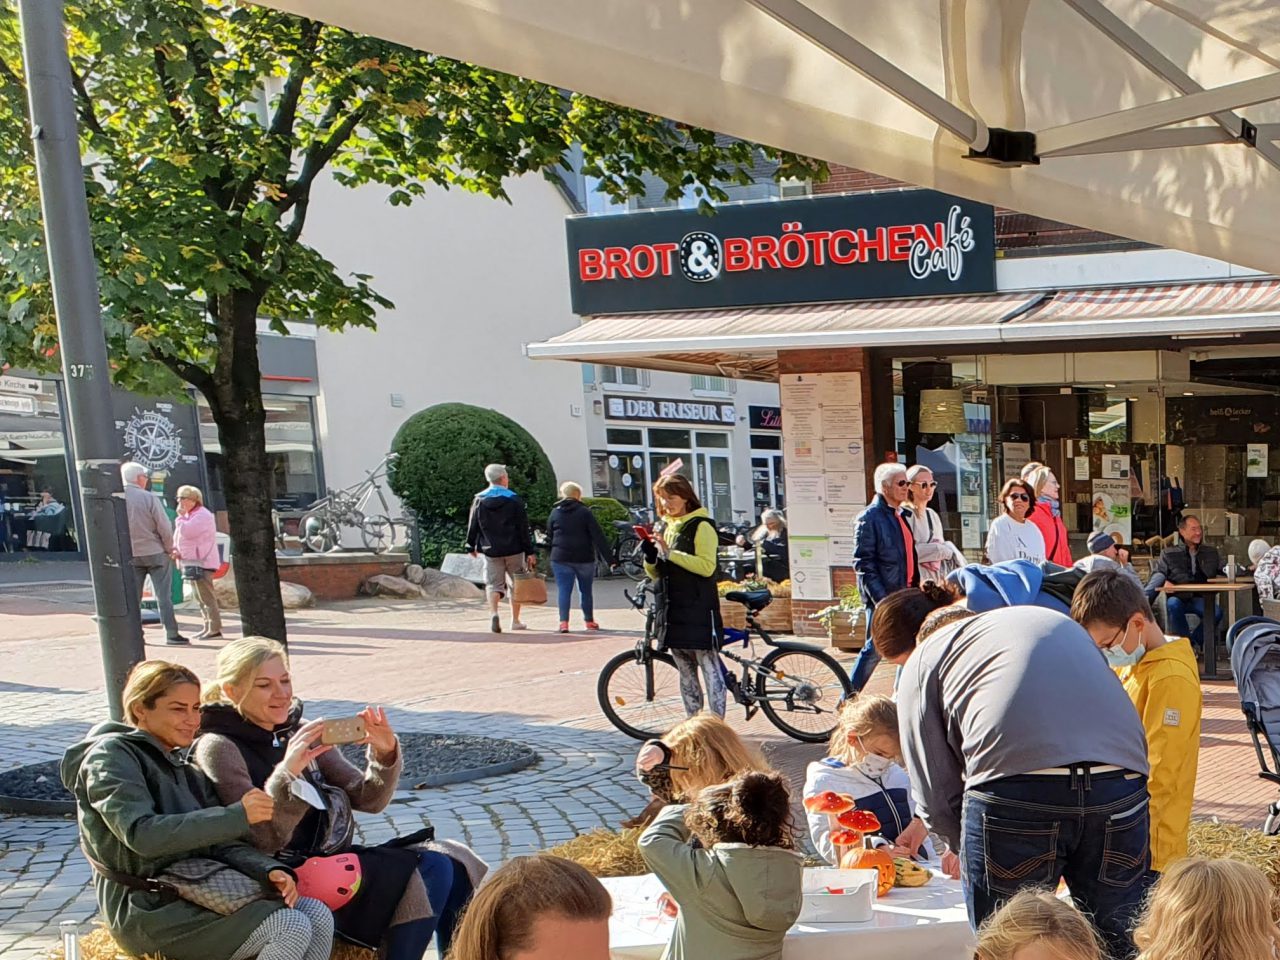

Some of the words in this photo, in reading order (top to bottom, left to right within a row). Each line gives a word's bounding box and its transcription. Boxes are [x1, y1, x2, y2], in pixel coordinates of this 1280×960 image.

[578, 243, 677, 282] BROT
[683, 235, 721, 281] &
[723, 222, 946, 273] BRÖTCHEN
[908, 204, 975, 282] Café
[626, 400, 658, 418] DER
[659, 402, 720, 421] FRISEUR
